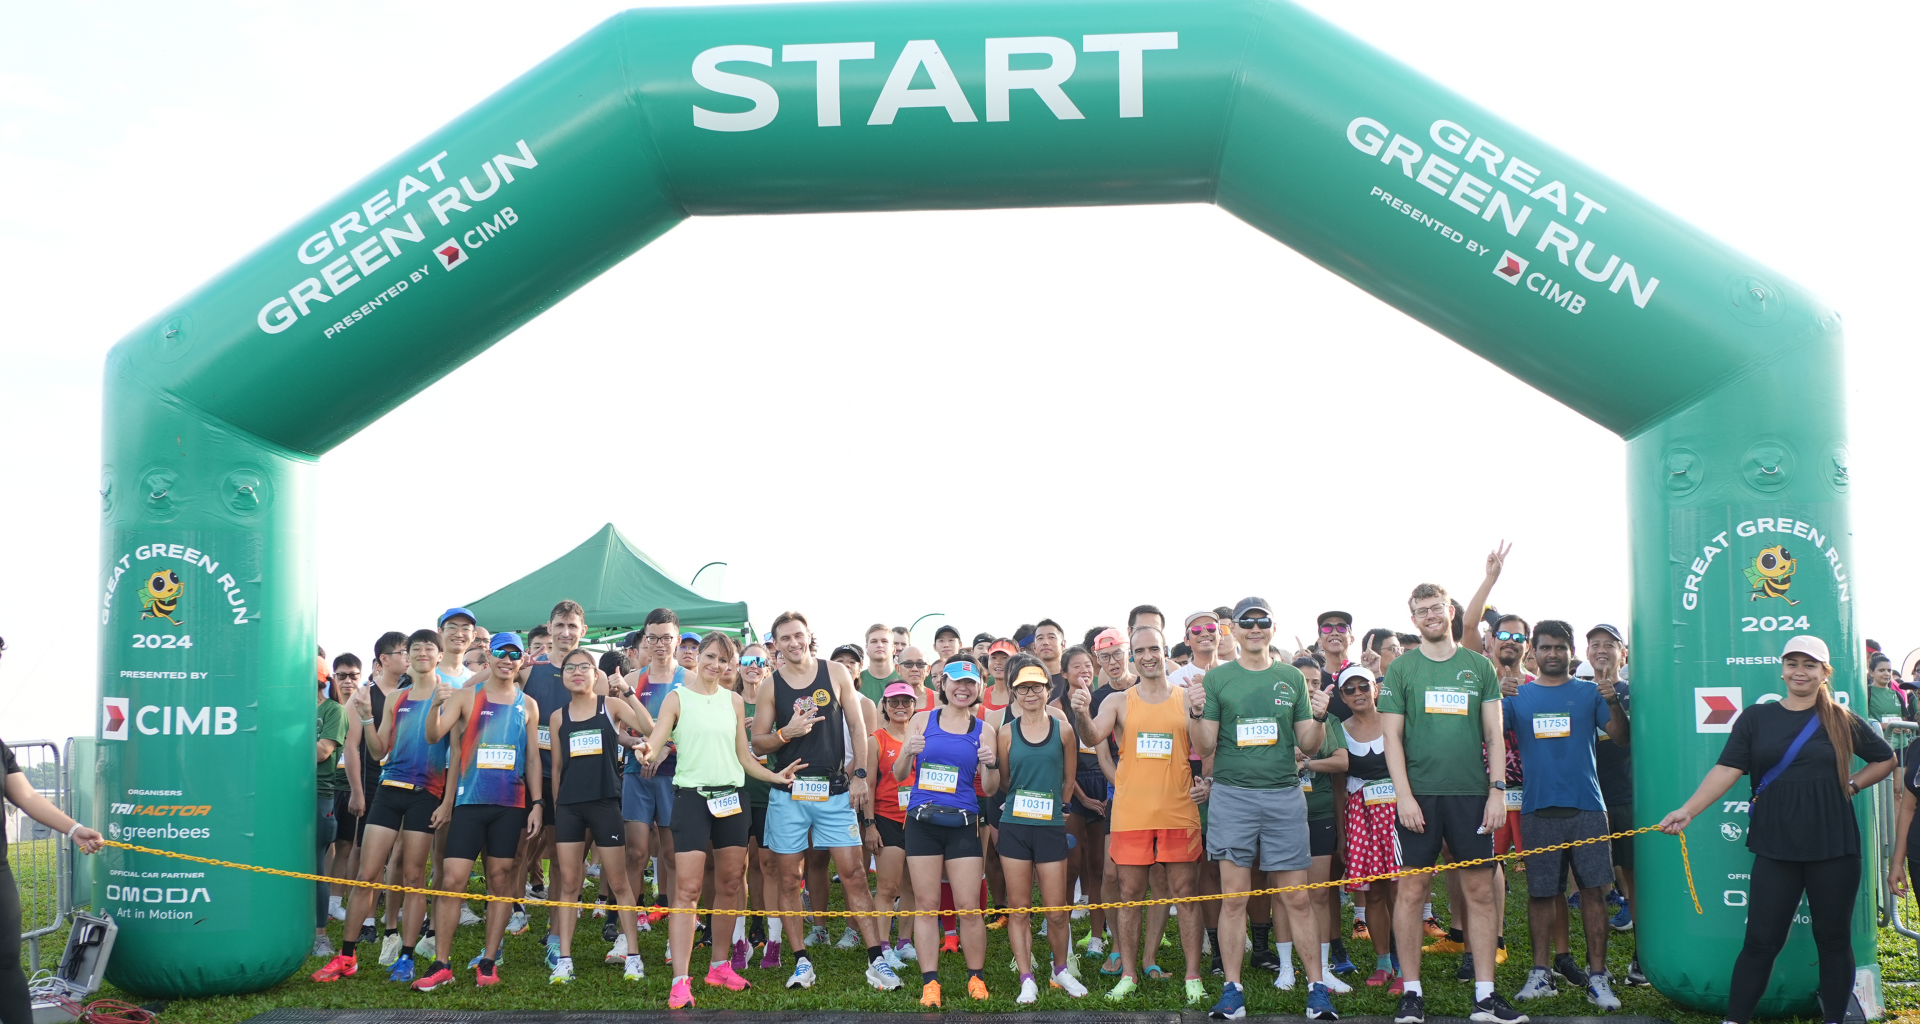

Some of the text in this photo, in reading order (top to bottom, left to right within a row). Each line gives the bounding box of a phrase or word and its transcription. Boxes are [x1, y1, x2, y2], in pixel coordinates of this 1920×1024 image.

[691, 31, 1178, 133] START
[1429, 119, 1608, 226] GREAT
[297, 150, 448, 265] GREAT
[1346, 116, 1660, 309] GREEN RUN
[463, 206, 519, 249] CIMB
[1370, 185, 1490, 257] PRESENTED BY
[257, 138, 539, 335] GREEN RUN
[1526, 272, 1587, 315] CIMB
[323, 264, 430, 340] PRESENTED BY
[1682, 517, 1851, 611] GREAT GREEN RUN
[102, 543, 249, 625] GREAT GREEN RUN
[1741, 614, 1810, 632] 2024
[132, 633, 193, 649] 2024
[1726, 656, 1783, 665] PRESEN
[120, 670, 208, 680] PRESENTED BY
[1434, 693, 1466, 704] 11008
[135, 704, 238, 735] CIMB
[1536, 718, 1568, 729] 11753
[1245, 725, 1276, 736] 11393
[572, 736, 600, 747] 11996
[1140, 740, 1171, 750] 11713
[485, 751, 514, 761] 11175
[926, 771, 956, 783] 10370
[127, 788, 183, 797] ORGANISERS
[799, 782, 828, 793] 11099
[1370, 785, 1394, 795] 1029
[110, 802, 212, 817] TRIFACTOR
[713, 795, 738, 809] 11569
[1022, 798, 1051, 810] 10311
[122, 822, 211, 841] greenbees
[109, 869, 140, 878] OFFICIAL
[141, 871, 159, 879] CAR
[106, 884, 212, 903] OMODA
[116, 907, 193, 920] Art in Motion
